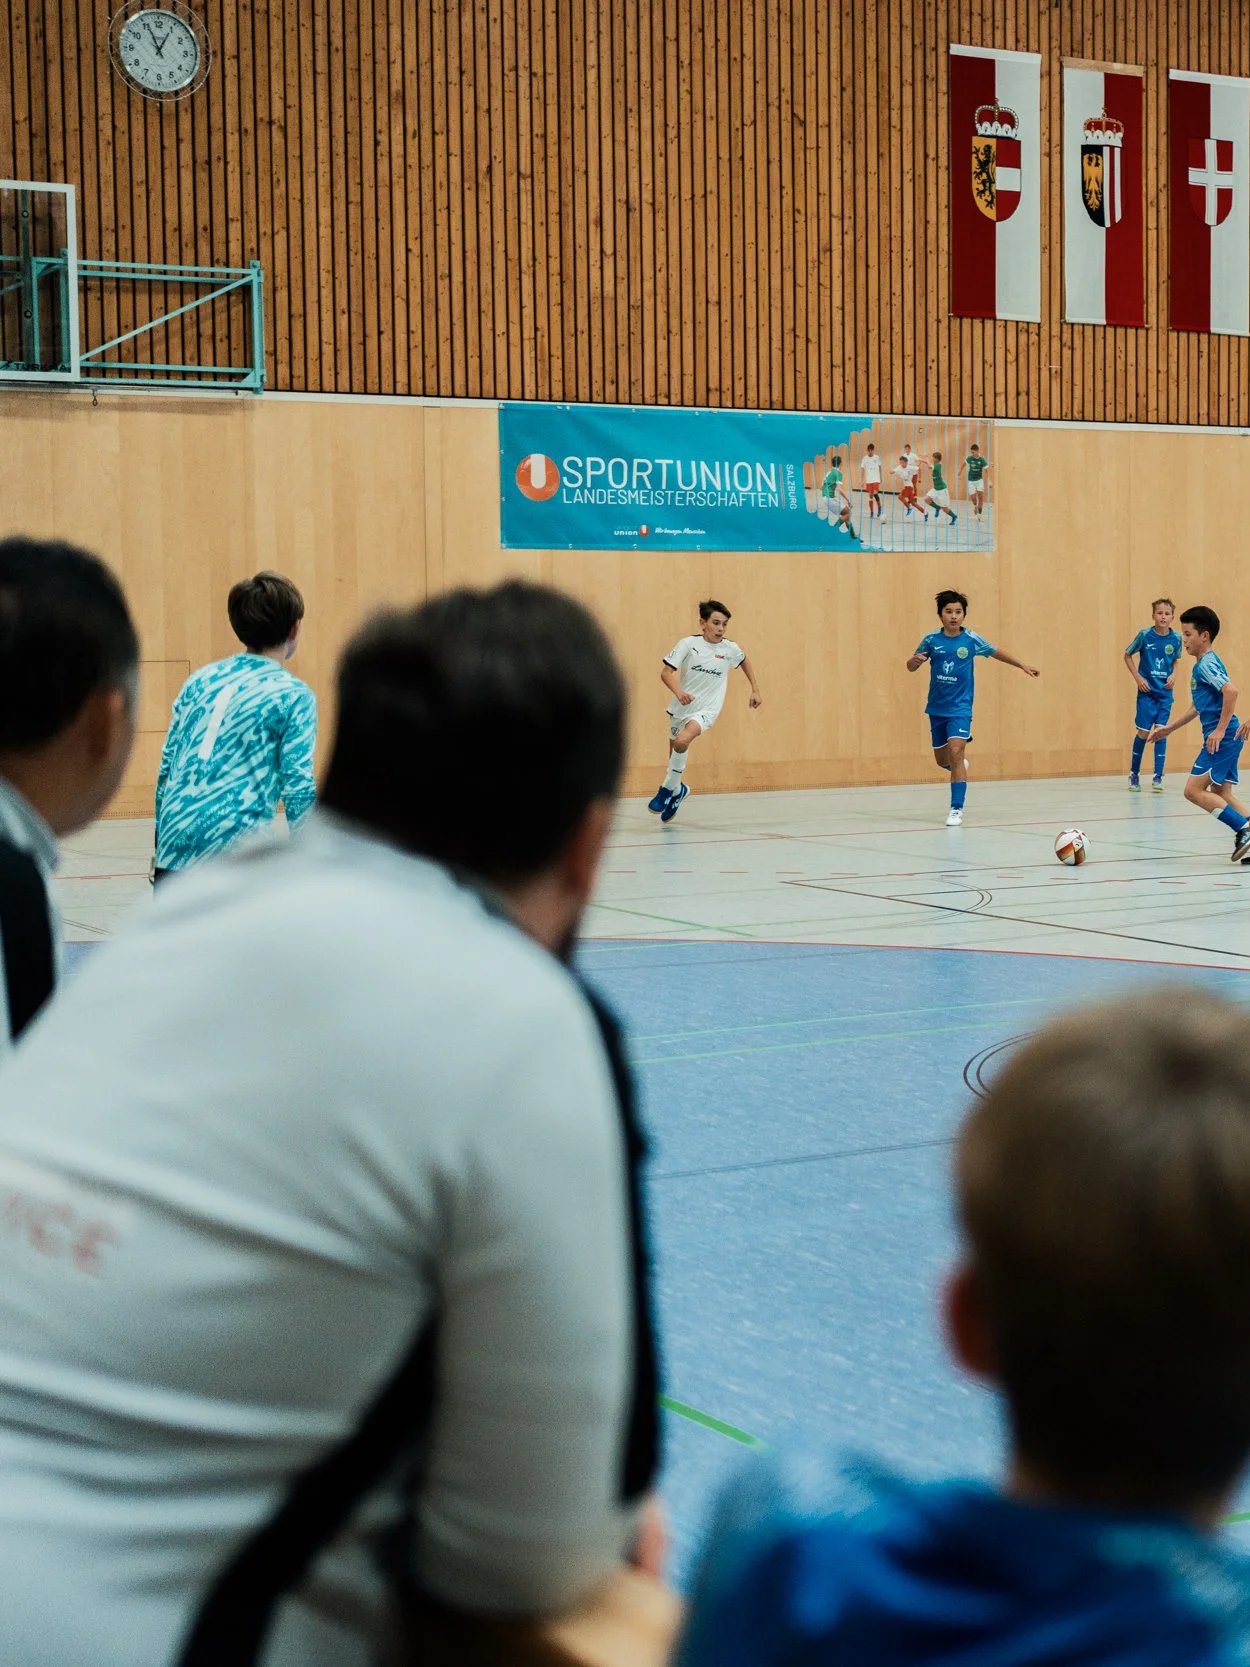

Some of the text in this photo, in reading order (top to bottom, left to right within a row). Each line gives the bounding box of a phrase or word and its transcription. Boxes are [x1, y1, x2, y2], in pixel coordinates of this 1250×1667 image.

[142, 22, 151, 31] 11
[154, 20, 163, 29] 12
[170, 26, 174, 34] 1
[133, 31, 141, 40] 10
[177, 37, 183, 45] 2
[134, 58, 140, 66] 8
[143, 68, 149, 76] 7
[169, 71, 174, 79] 5
[157, 73, 162, 81] 6
[562, 455, 778, 494] SPORTUNION
[786, 463, 799, 511] SALZBURG
[562, 488, 779, 508] LANDESMEISTERSCHAFTEN
[197, 682, 239, 762] 1
